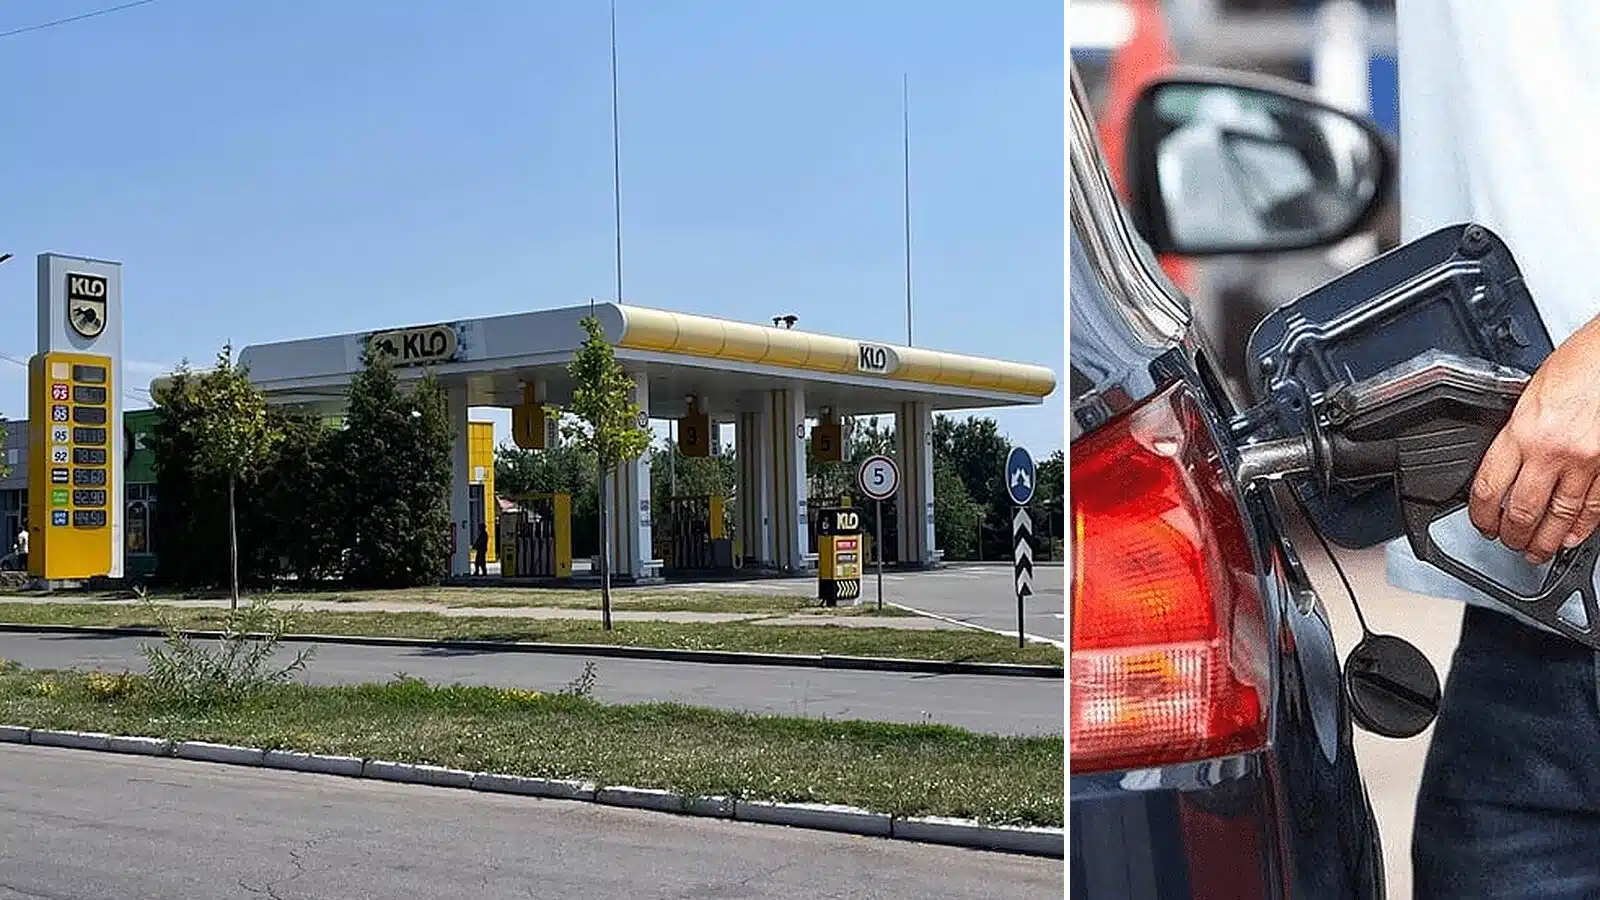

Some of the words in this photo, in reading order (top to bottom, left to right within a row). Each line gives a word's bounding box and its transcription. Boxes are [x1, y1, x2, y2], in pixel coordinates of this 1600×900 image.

[72, 277, 105, 297] KLO
[402, 330, 447, 359] KLO
[860, 346, 886, 369] KLO
[53, 389, 68, 401] 95
[54, 430, 68, 442] 95
[54, 451, 68, 462] 92
[873, 467, 885, 486] 5
[836, 512, 860, 530] KLO
